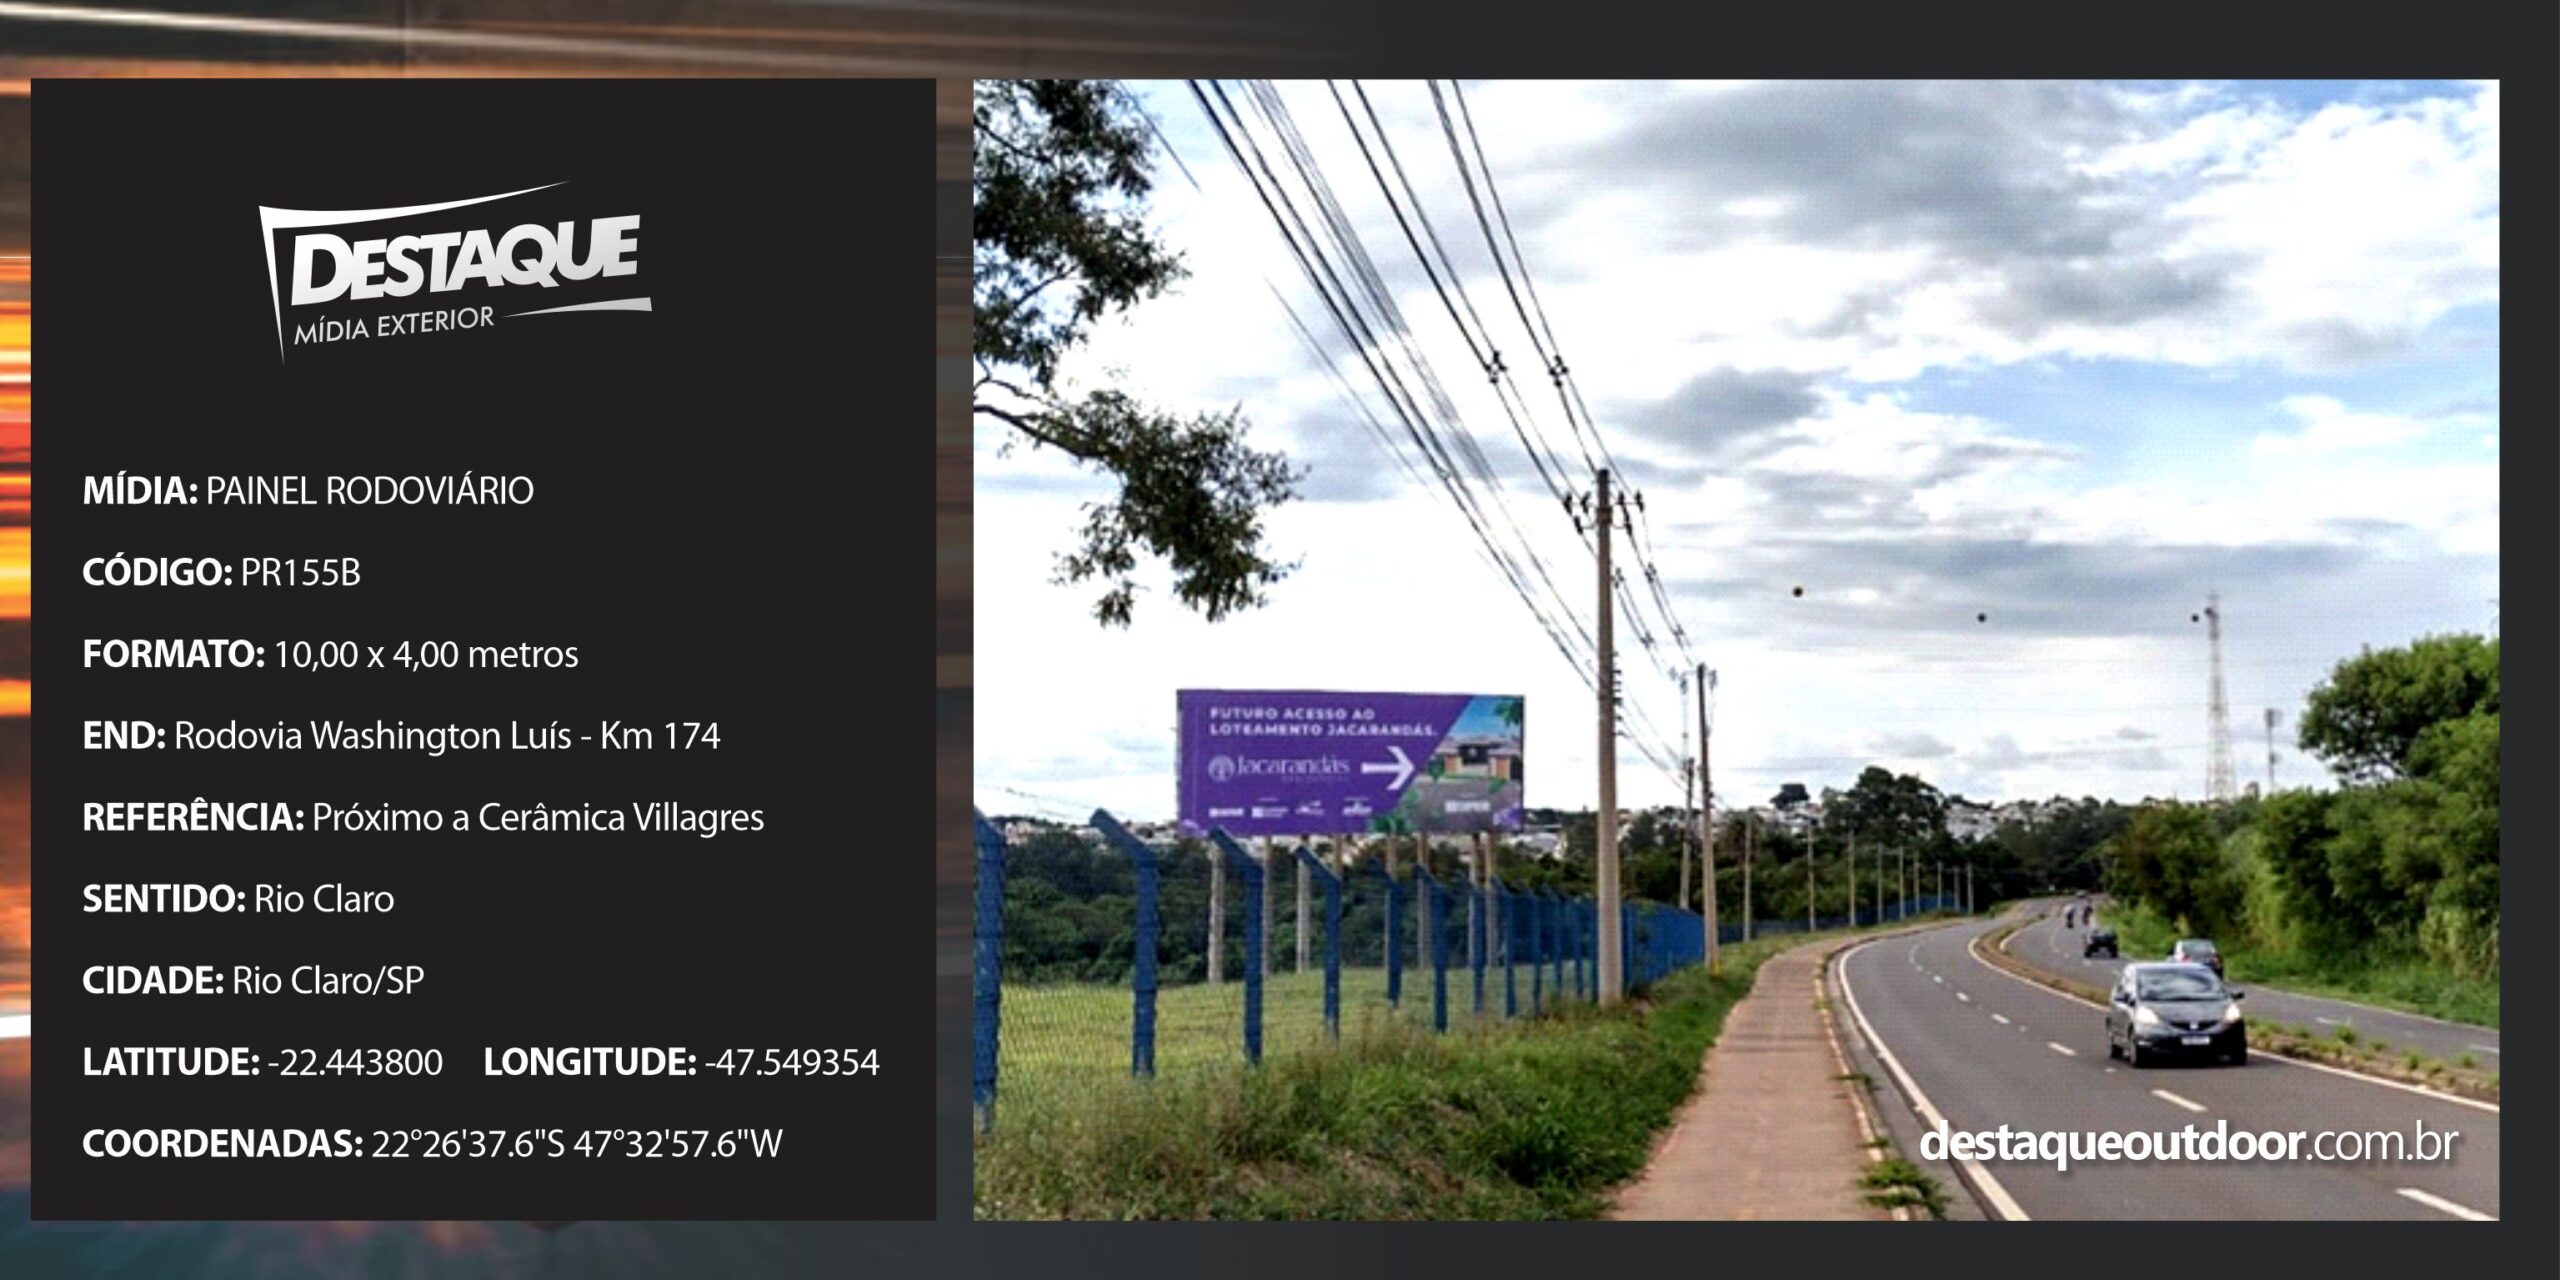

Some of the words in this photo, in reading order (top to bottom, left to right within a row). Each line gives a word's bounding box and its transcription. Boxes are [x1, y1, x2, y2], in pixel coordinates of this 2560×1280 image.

[1210, 707, 1279, 720] FUTURO
[1283, 707, 1347, 721] ACESSO
[1351, 708, 1375, 721] AO
[1210, 723, 1322, 737] LOTEAMENTO
[1237, 755, 1350, 777] Jacarandás
